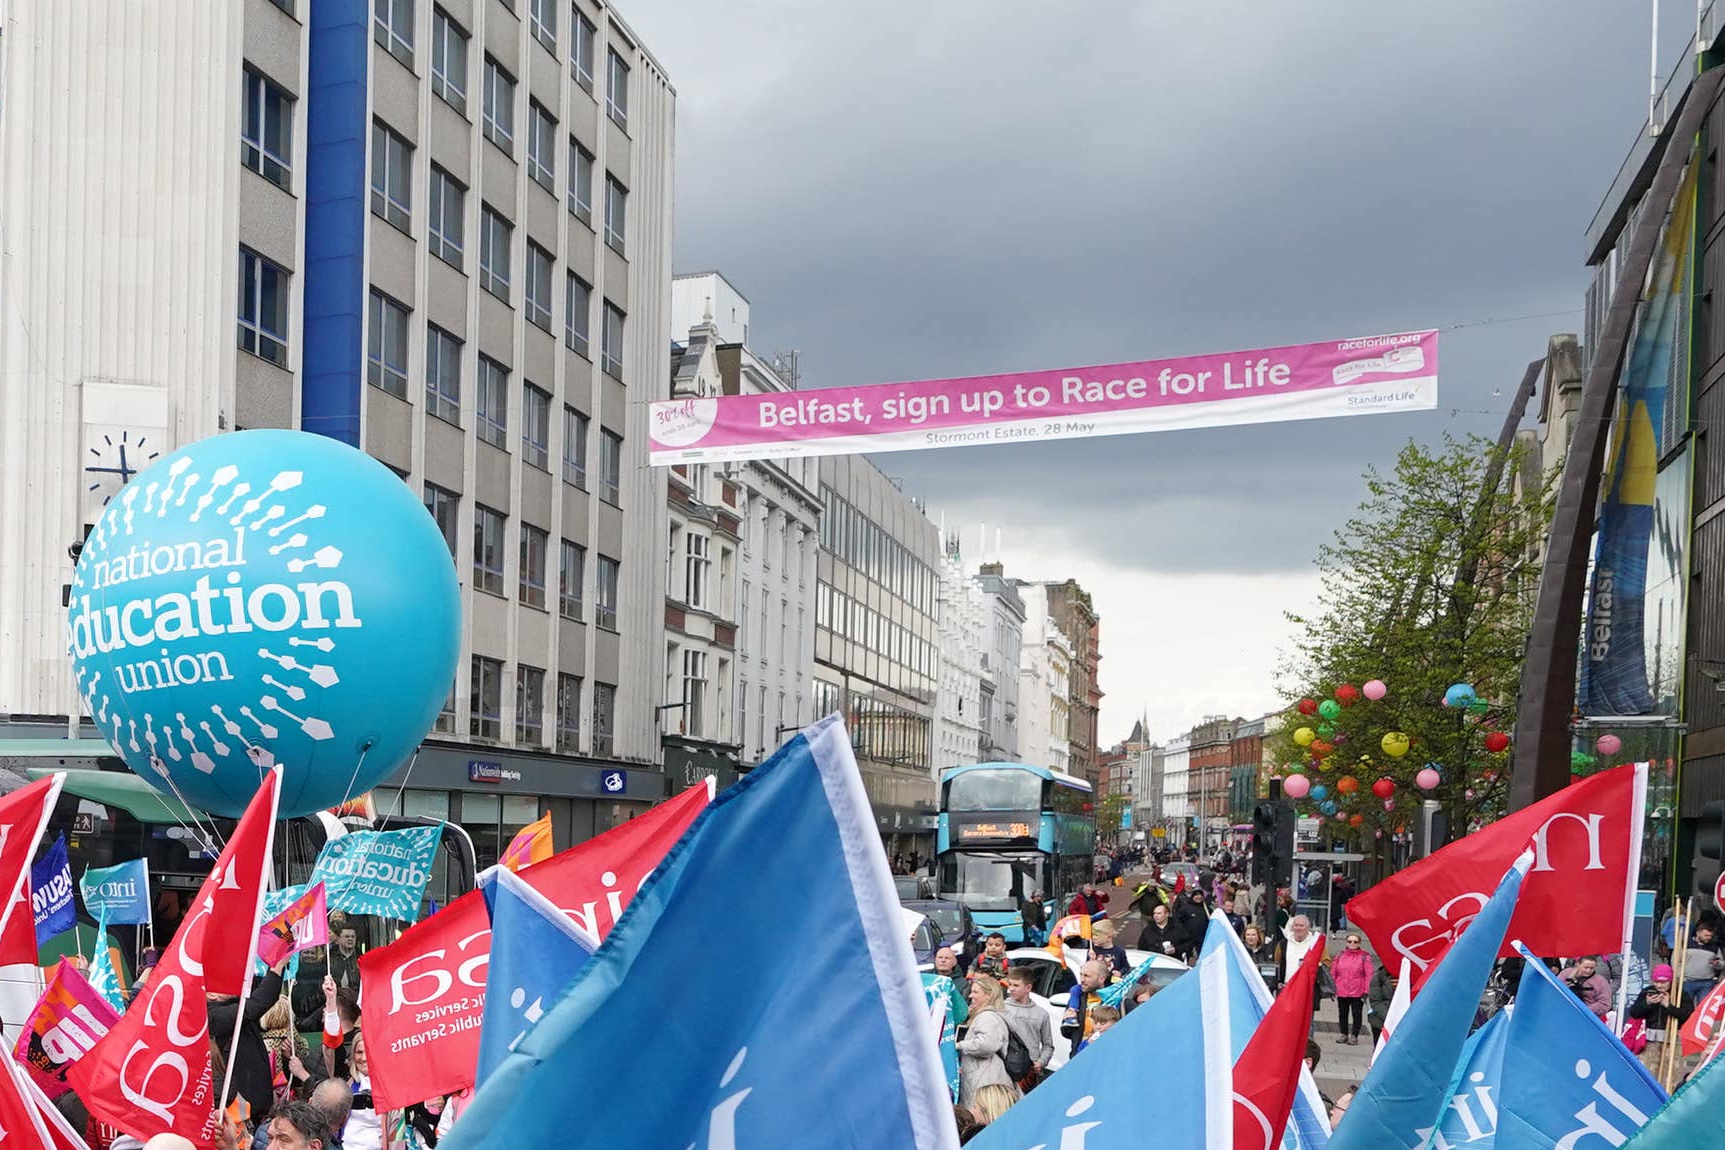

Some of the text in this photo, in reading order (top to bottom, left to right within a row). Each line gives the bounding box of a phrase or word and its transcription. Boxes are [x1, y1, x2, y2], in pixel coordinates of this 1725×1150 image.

[759, 358, 1292, 428] Belfast, sign up to Race for Life
[925, 420, 1096, 445] Stormont Estate, 28 May
[92, 526, 247, 590] national
[114, 647, 235, 695] union
